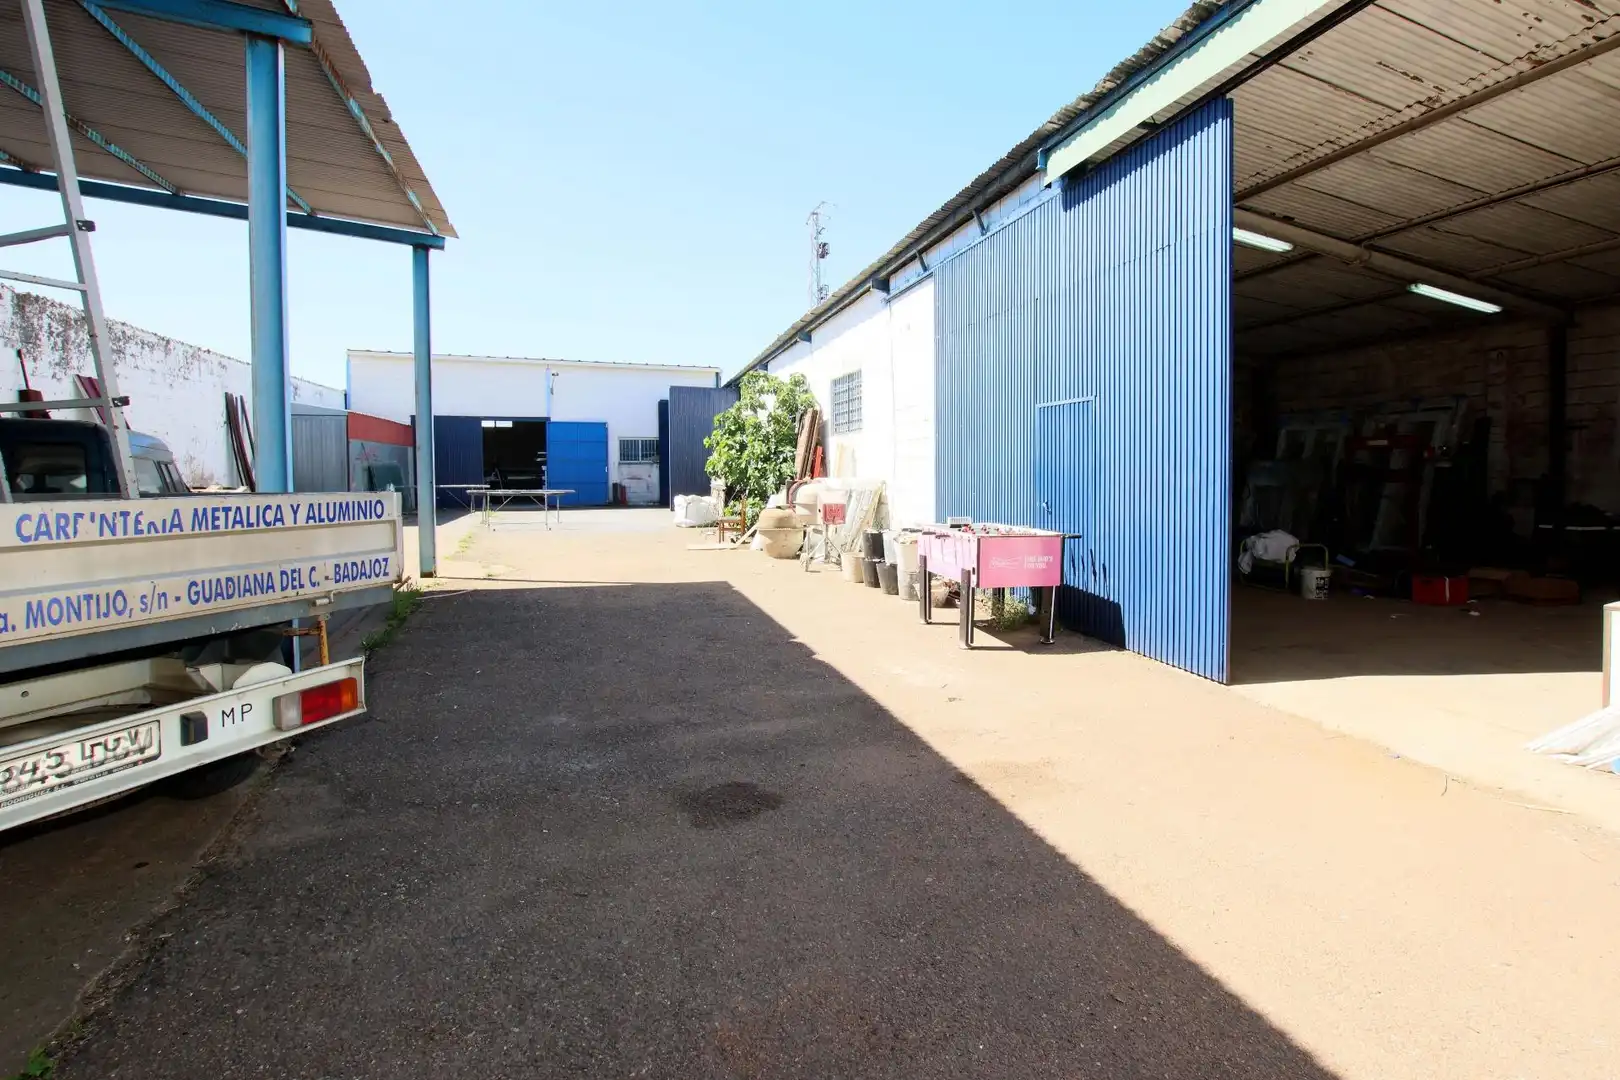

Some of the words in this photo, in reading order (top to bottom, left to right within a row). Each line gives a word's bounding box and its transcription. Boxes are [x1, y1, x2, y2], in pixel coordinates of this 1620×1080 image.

[191, 504, 285, 532] METALICA
[290, 503, 300, 525] Y
[305, 499, 385, 524] ALUMINIO
[25, 589, 133, 629] MONTIJO,
[139, 583, 168, 614] s/n
[187, 571, 275, 606] GUADIANA
[280, 568, 304, 593] DEL
[309, 566, 320, 588] C.
[334, 557, 389, 584] BADAJOZ
